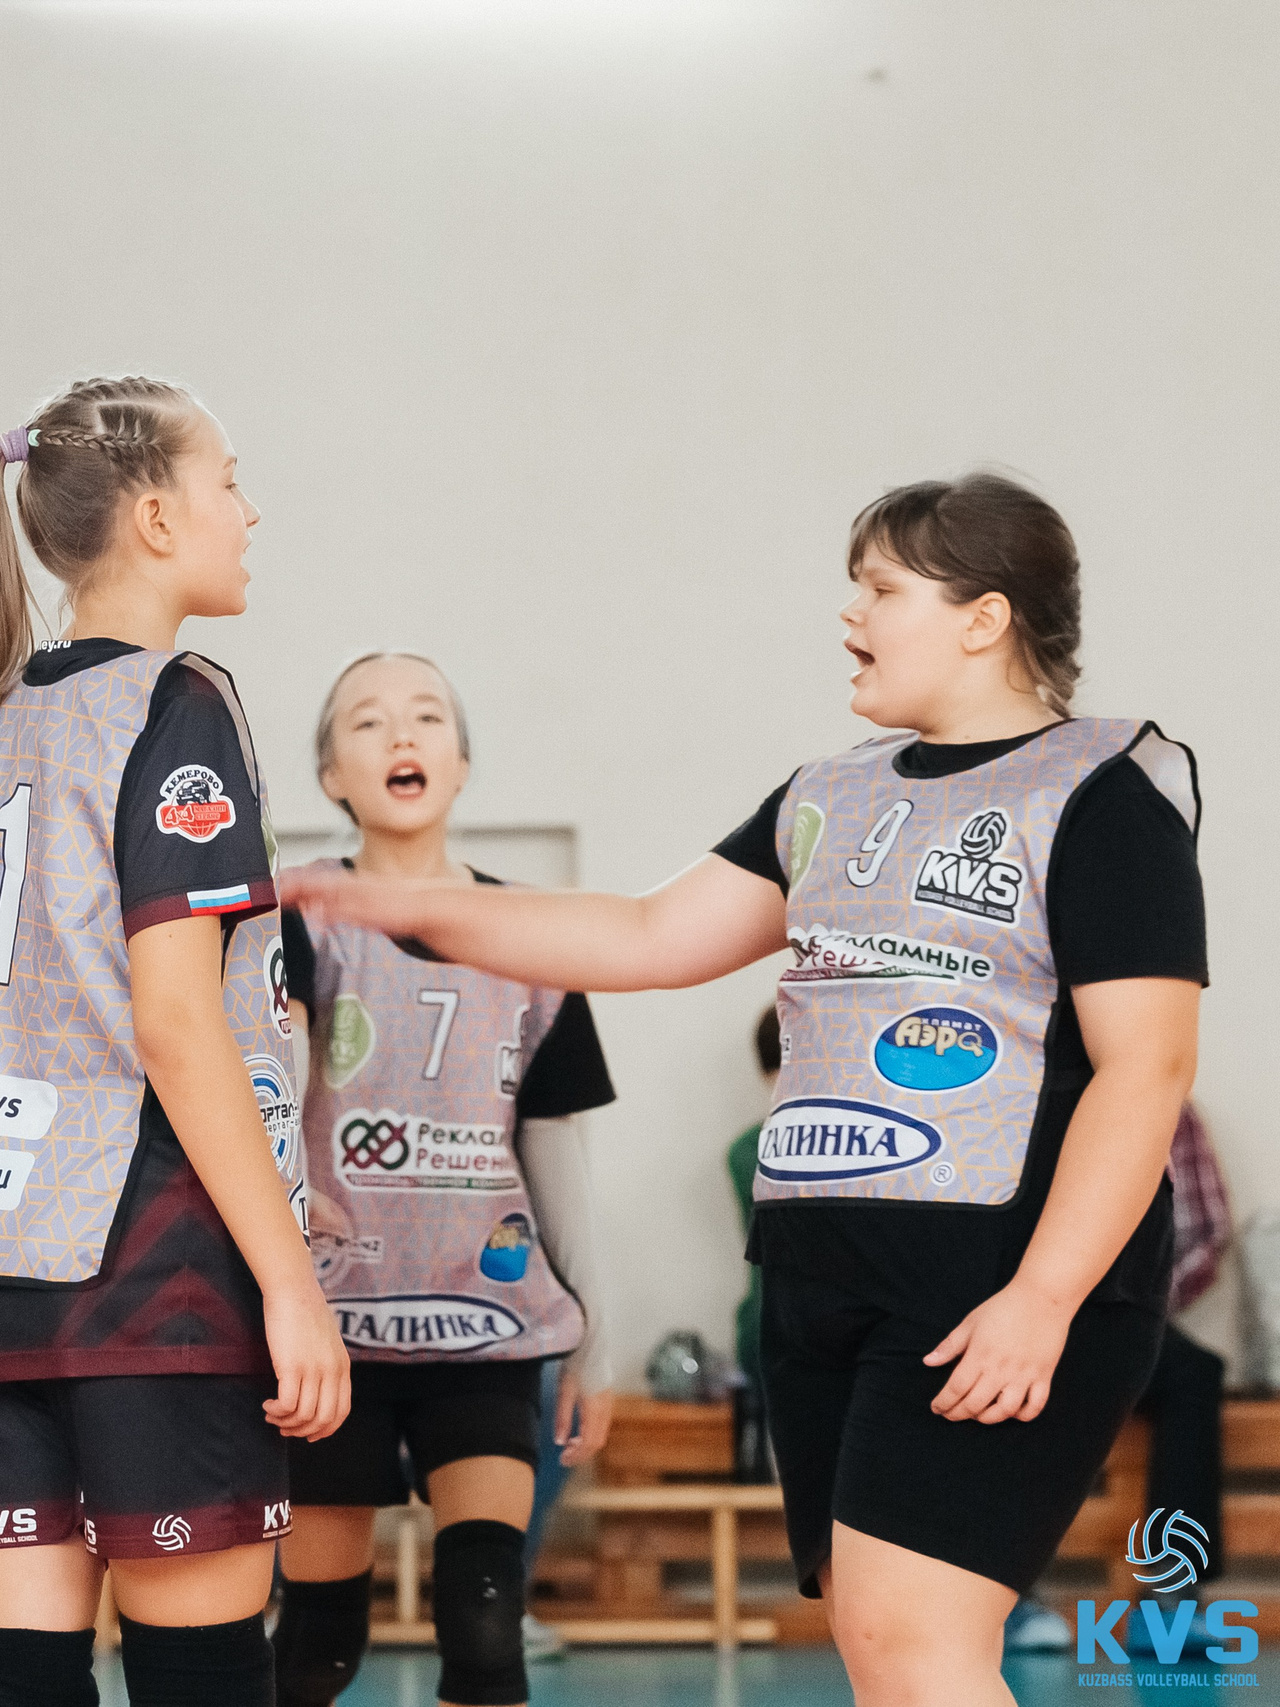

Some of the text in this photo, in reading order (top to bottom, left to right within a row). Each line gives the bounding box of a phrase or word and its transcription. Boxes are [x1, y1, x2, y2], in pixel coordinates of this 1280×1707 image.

[164, 769, 220, 795] КЕМЕРОВО
[845, 798, 914, 888] 9
[915, 849, 1023, 909] KVS
[418, 988, 460, 1081] 7
